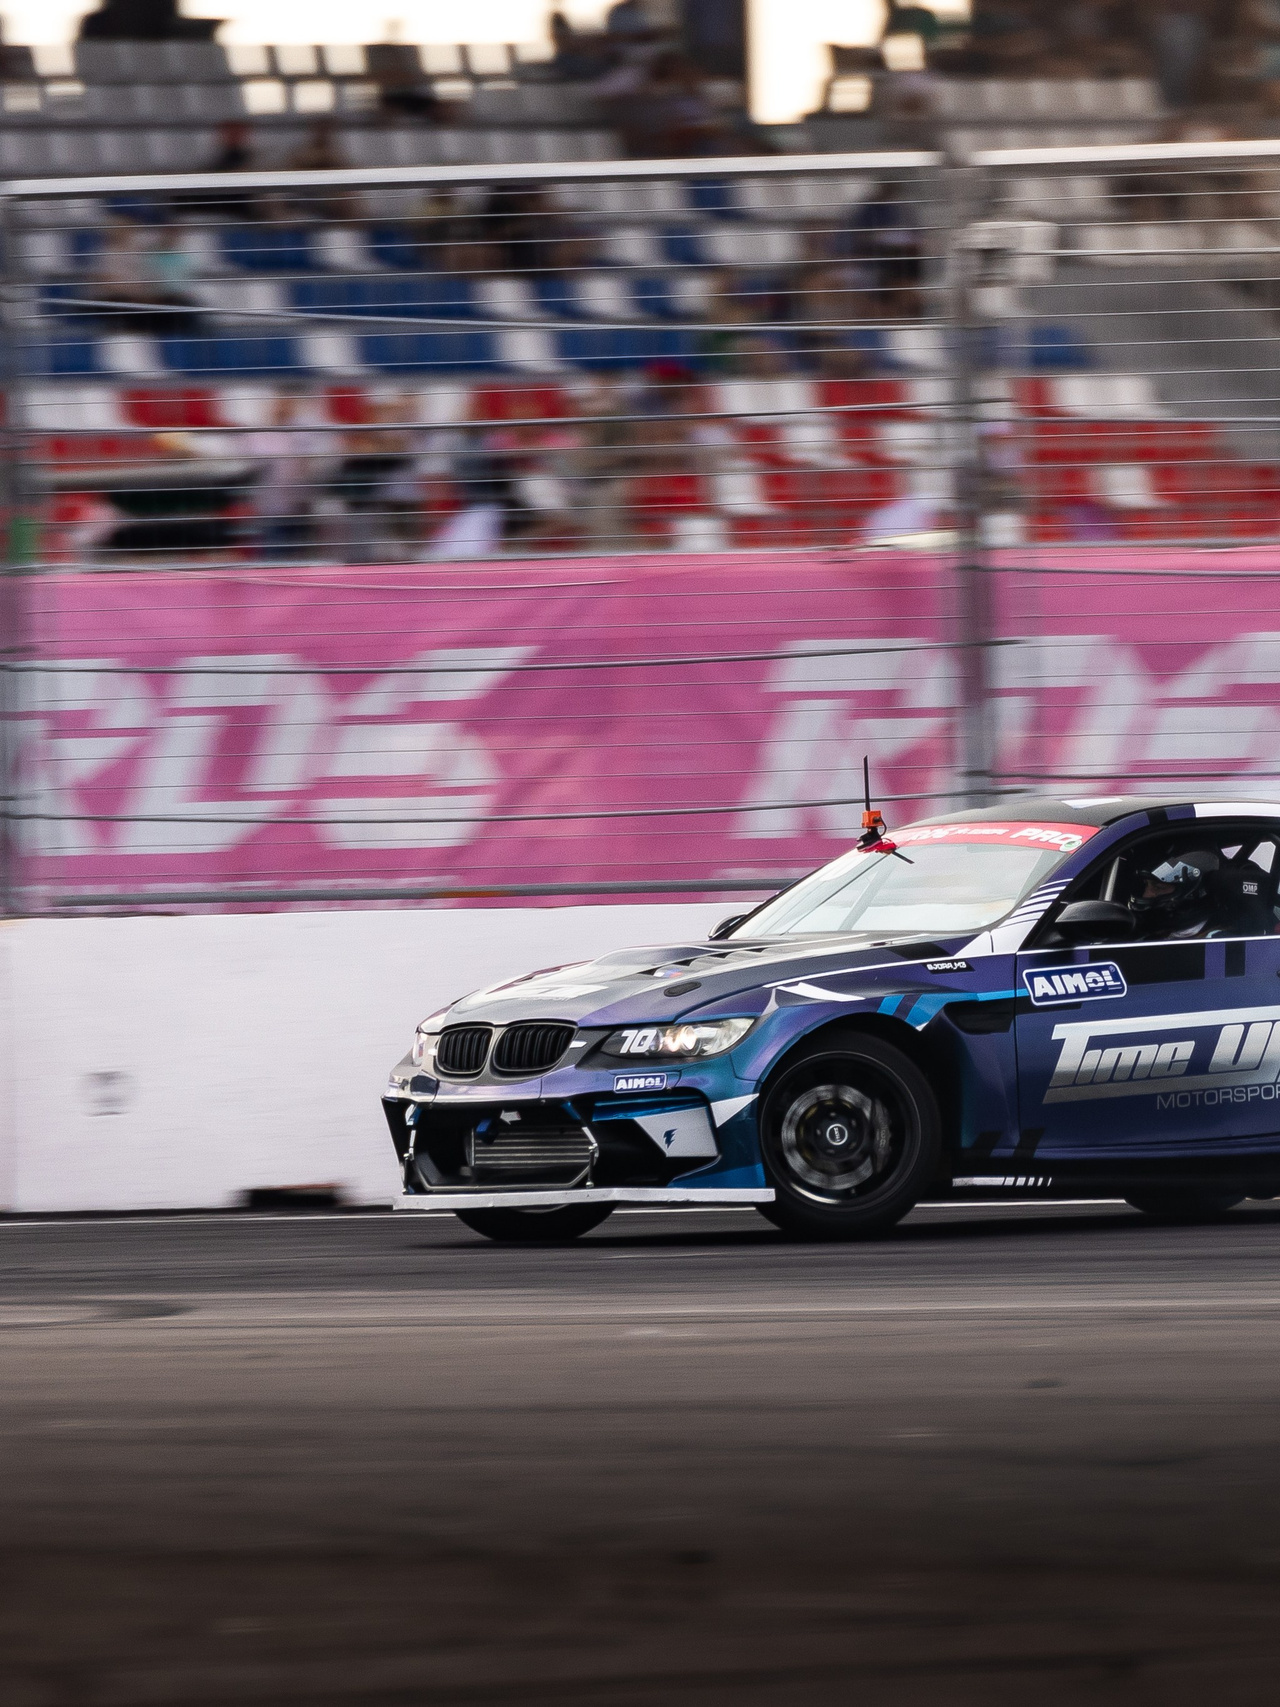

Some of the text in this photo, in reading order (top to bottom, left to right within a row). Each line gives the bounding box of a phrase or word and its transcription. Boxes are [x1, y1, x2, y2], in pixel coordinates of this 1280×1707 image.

[1009, 827, 1083, 846] PRO
[1242, 884, 1258, 893] OMP
[620, 1028, 657, 1054] 70
[616, 1076, 664, 1090] AIMOL
